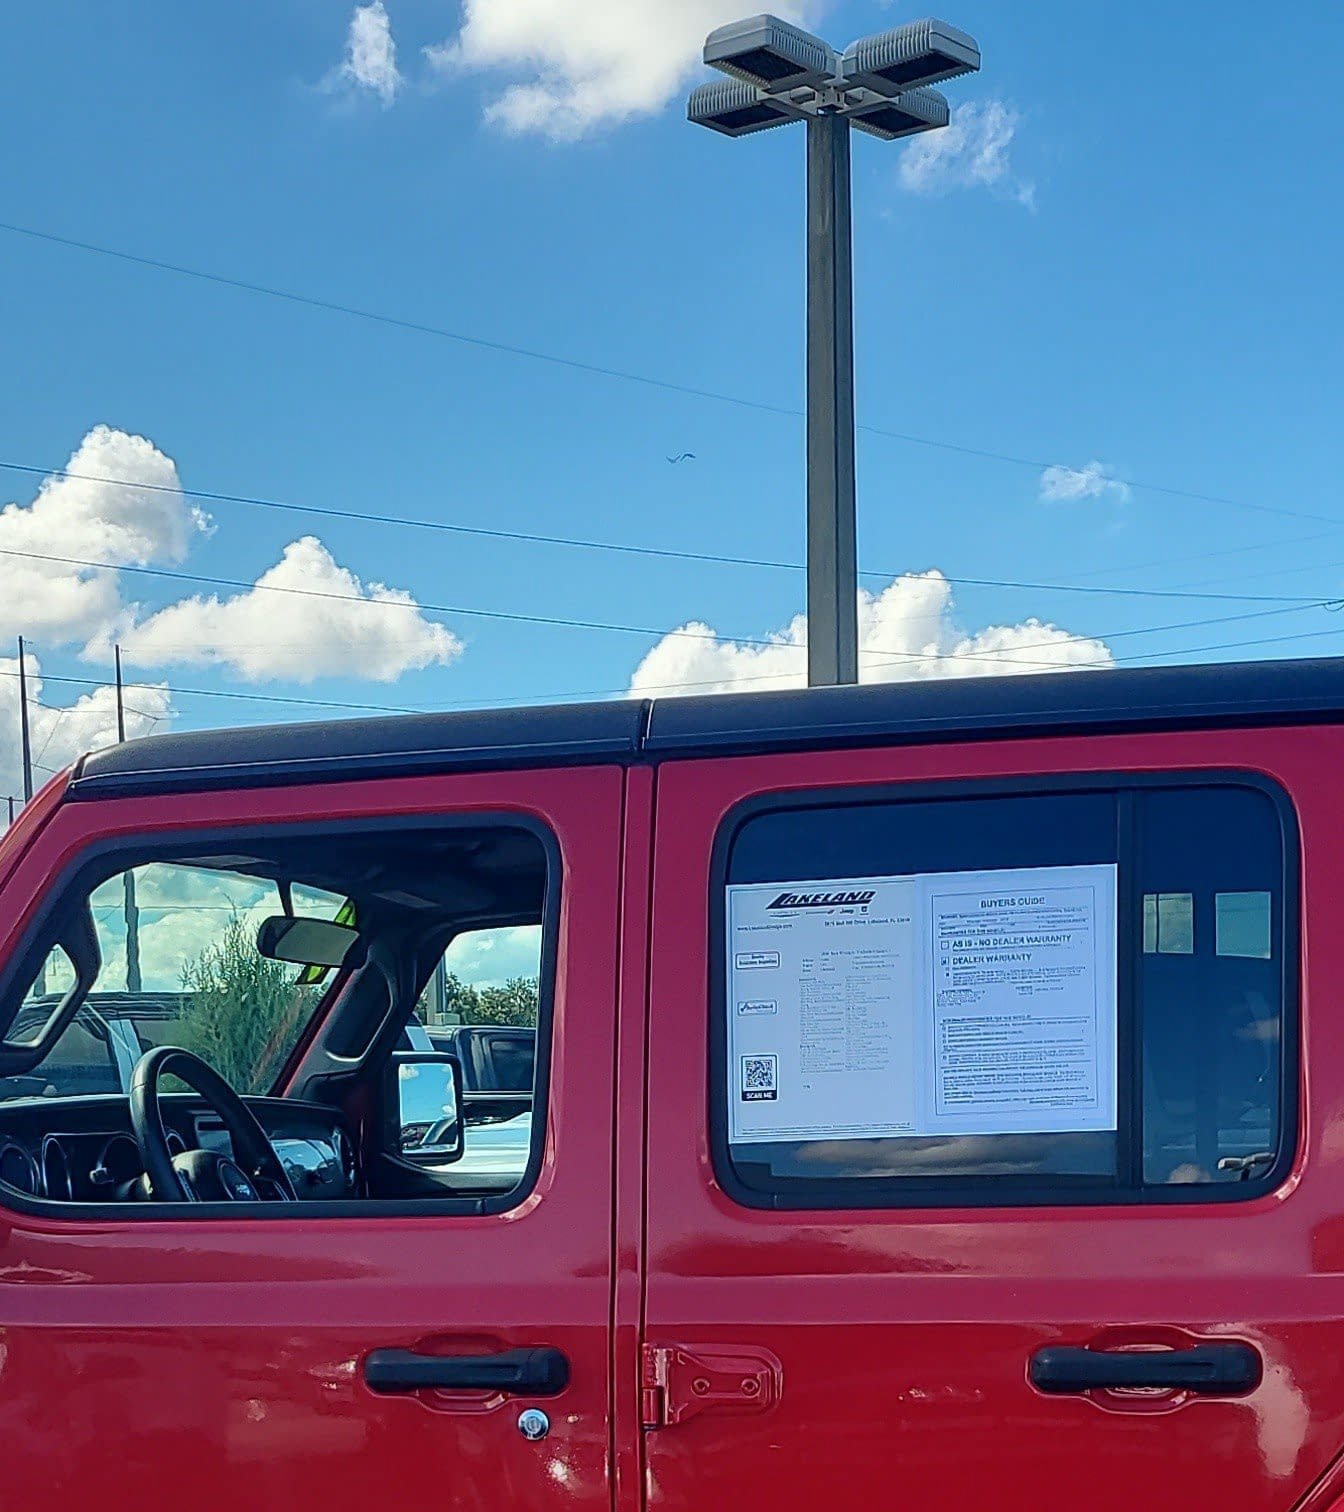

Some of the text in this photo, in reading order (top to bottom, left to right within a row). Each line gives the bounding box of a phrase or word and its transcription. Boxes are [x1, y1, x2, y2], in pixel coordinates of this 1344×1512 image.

[765, 891, 876, 909] LAKELAND
[980, 896, 1046, 909] BUYERS GUIDE
[952, 939, 963, 948] AS
[979, 938, 991, 946] NO
[992, 936, 1025, 945] DEALER
[1025, 934, 1072, 944] WARRANTY
[952, 952, 1032, 965] DEALER WARRANTY
